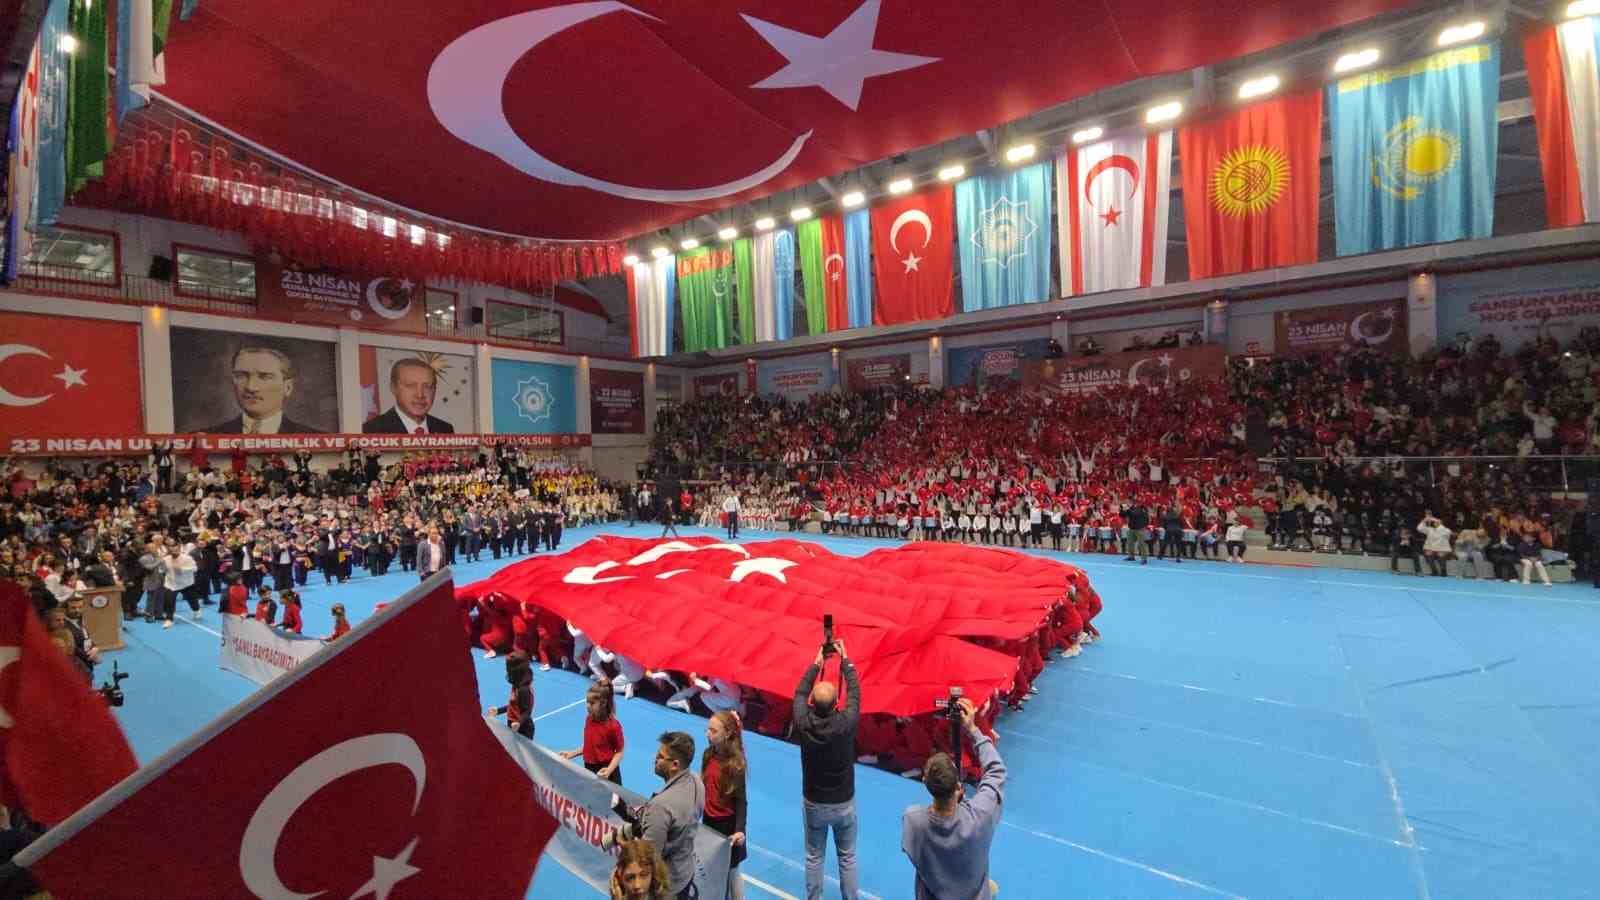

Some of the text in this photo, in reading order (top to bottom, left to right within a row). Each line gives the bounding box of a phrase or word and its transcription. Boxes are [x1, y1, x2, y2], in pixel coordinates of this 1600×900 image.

[281, 271, 303, 285] 23
[11, 438, 41, 453] 23
[324, 437, 345, 448] VE
[348, 437, 399, 448] OCUK
